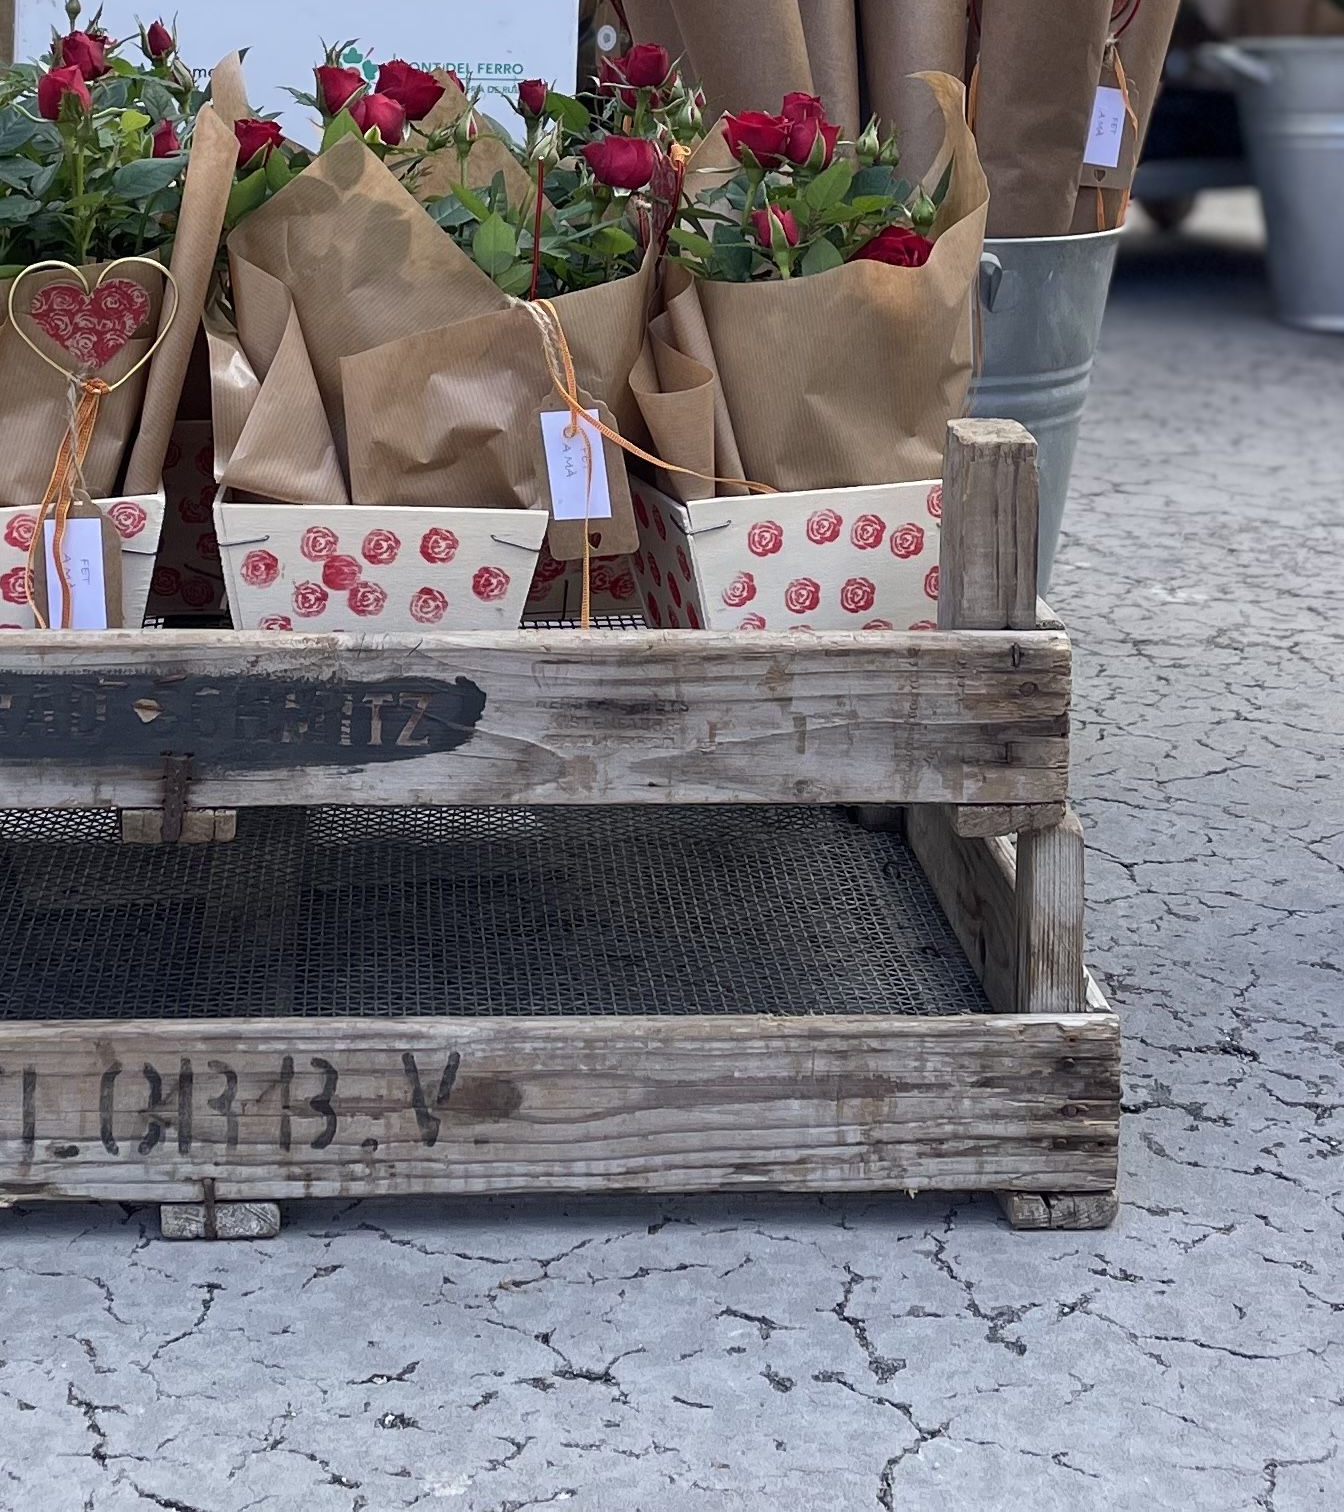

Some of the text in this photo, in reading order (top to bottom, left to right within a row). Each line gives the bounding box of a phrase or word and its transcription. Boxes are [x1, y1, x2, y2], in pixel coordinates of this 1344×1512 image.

[445, 62, 472, 74] DEL
[476, 62, 524, 76] FERRO
[80, 559, 90, 586] FET
